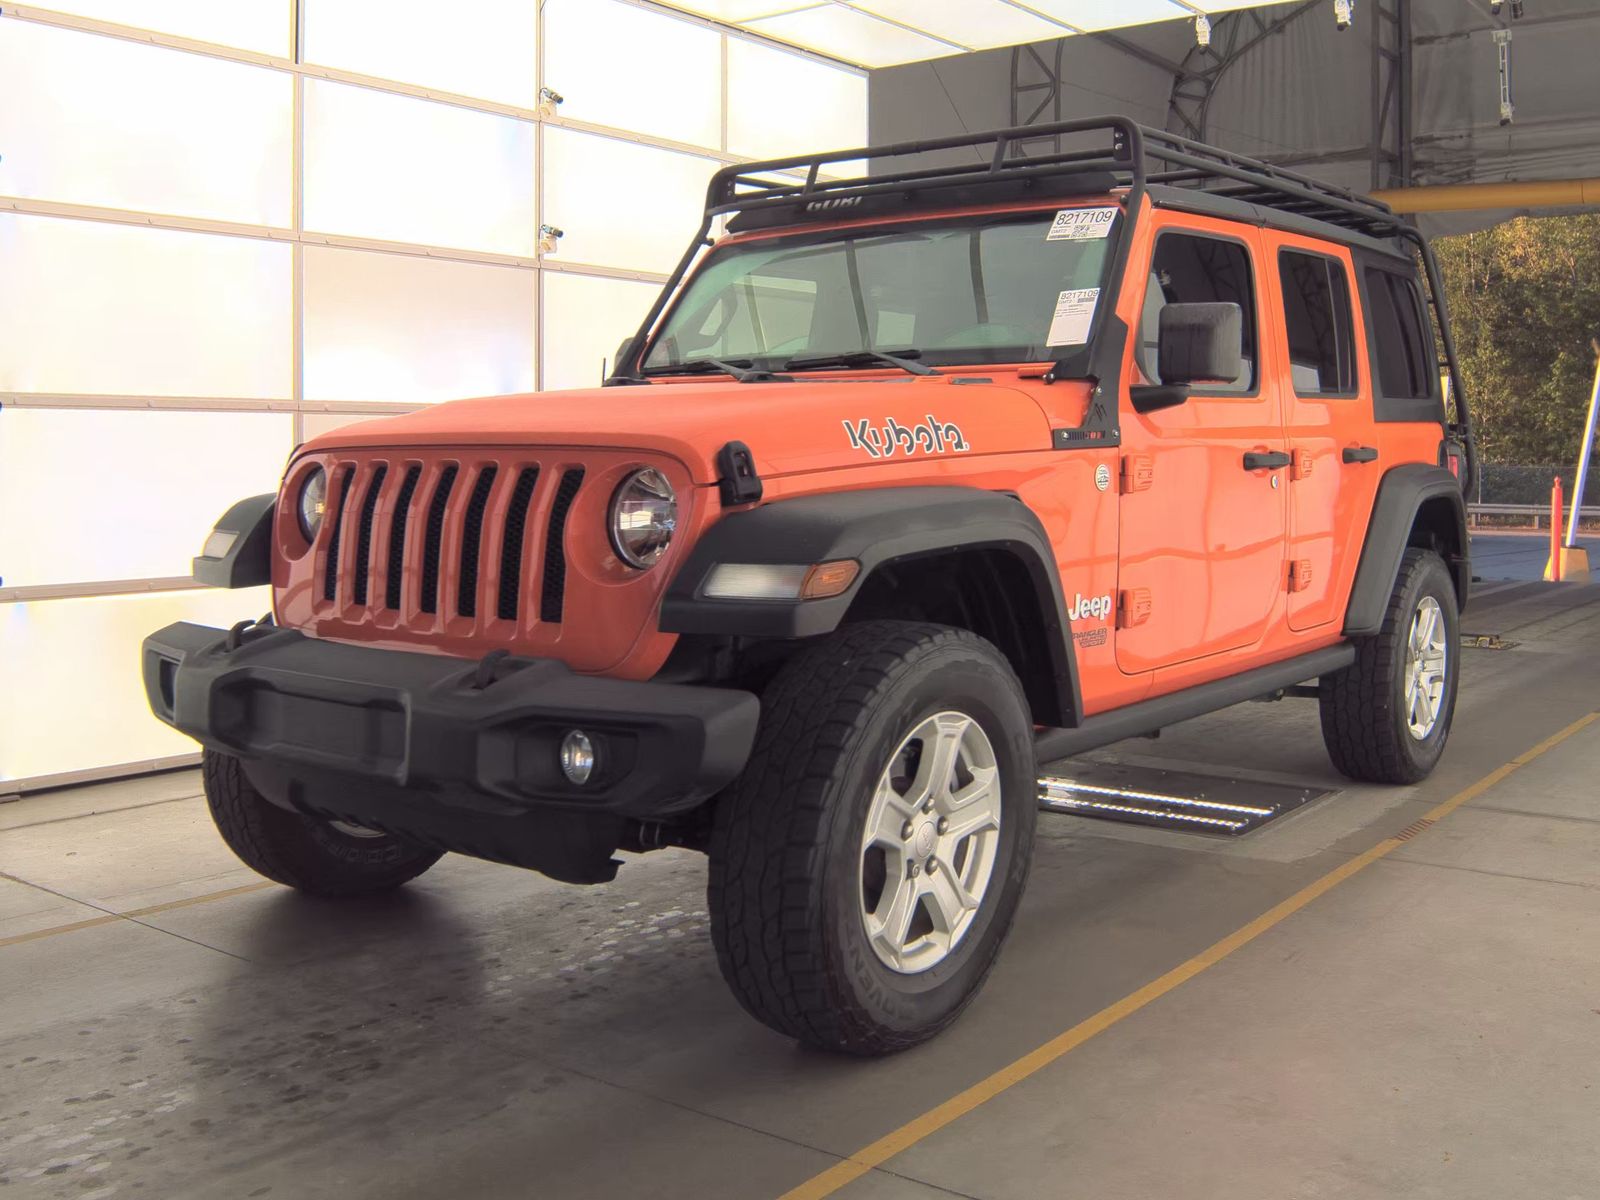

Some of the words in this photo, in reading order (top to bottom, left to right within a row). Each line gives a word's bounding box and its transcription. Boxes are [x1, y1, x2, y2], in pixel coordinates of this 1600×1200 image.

[1056, 210, 1113, 226] 8217109
[1060, 289, 1099, 300] 8217109
[842, 415, 965, 457] Kubota
[1068, 592, 1111, 621] Jeep
